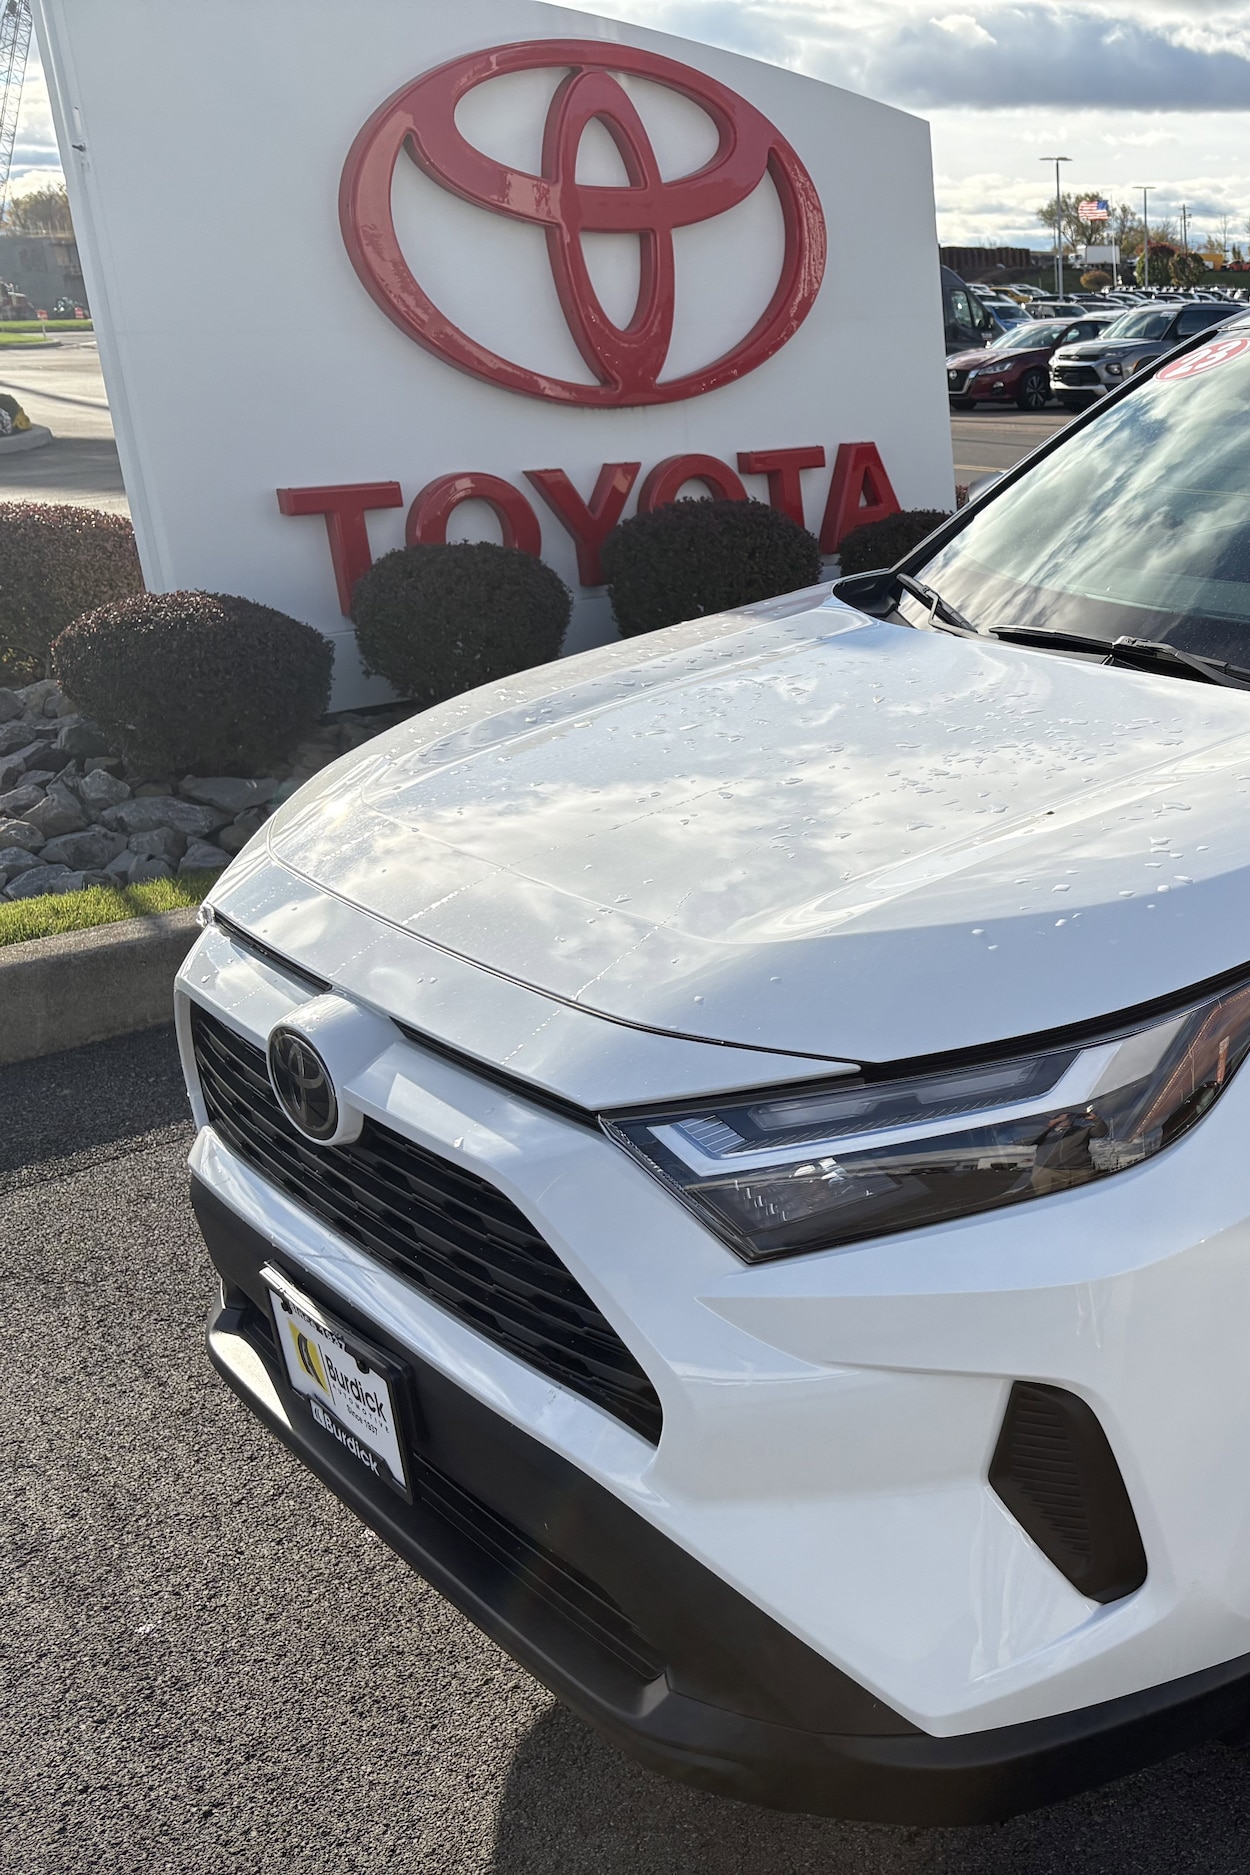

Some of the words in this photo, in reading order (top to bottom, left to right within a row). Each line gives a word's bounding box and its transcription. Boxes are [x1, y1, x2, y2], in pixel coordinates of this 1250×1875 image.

[1163, 340, 1242, 379] 23
[325, 1354, 387, 1422] Burdick
[332, 1384, 389, 1433] AUTOMOTIVE
[347, 1404, 363, 1424] Since
[363, 1418, 378, 1435] 1937
[323, 1415, 380, 1477] Burdick
